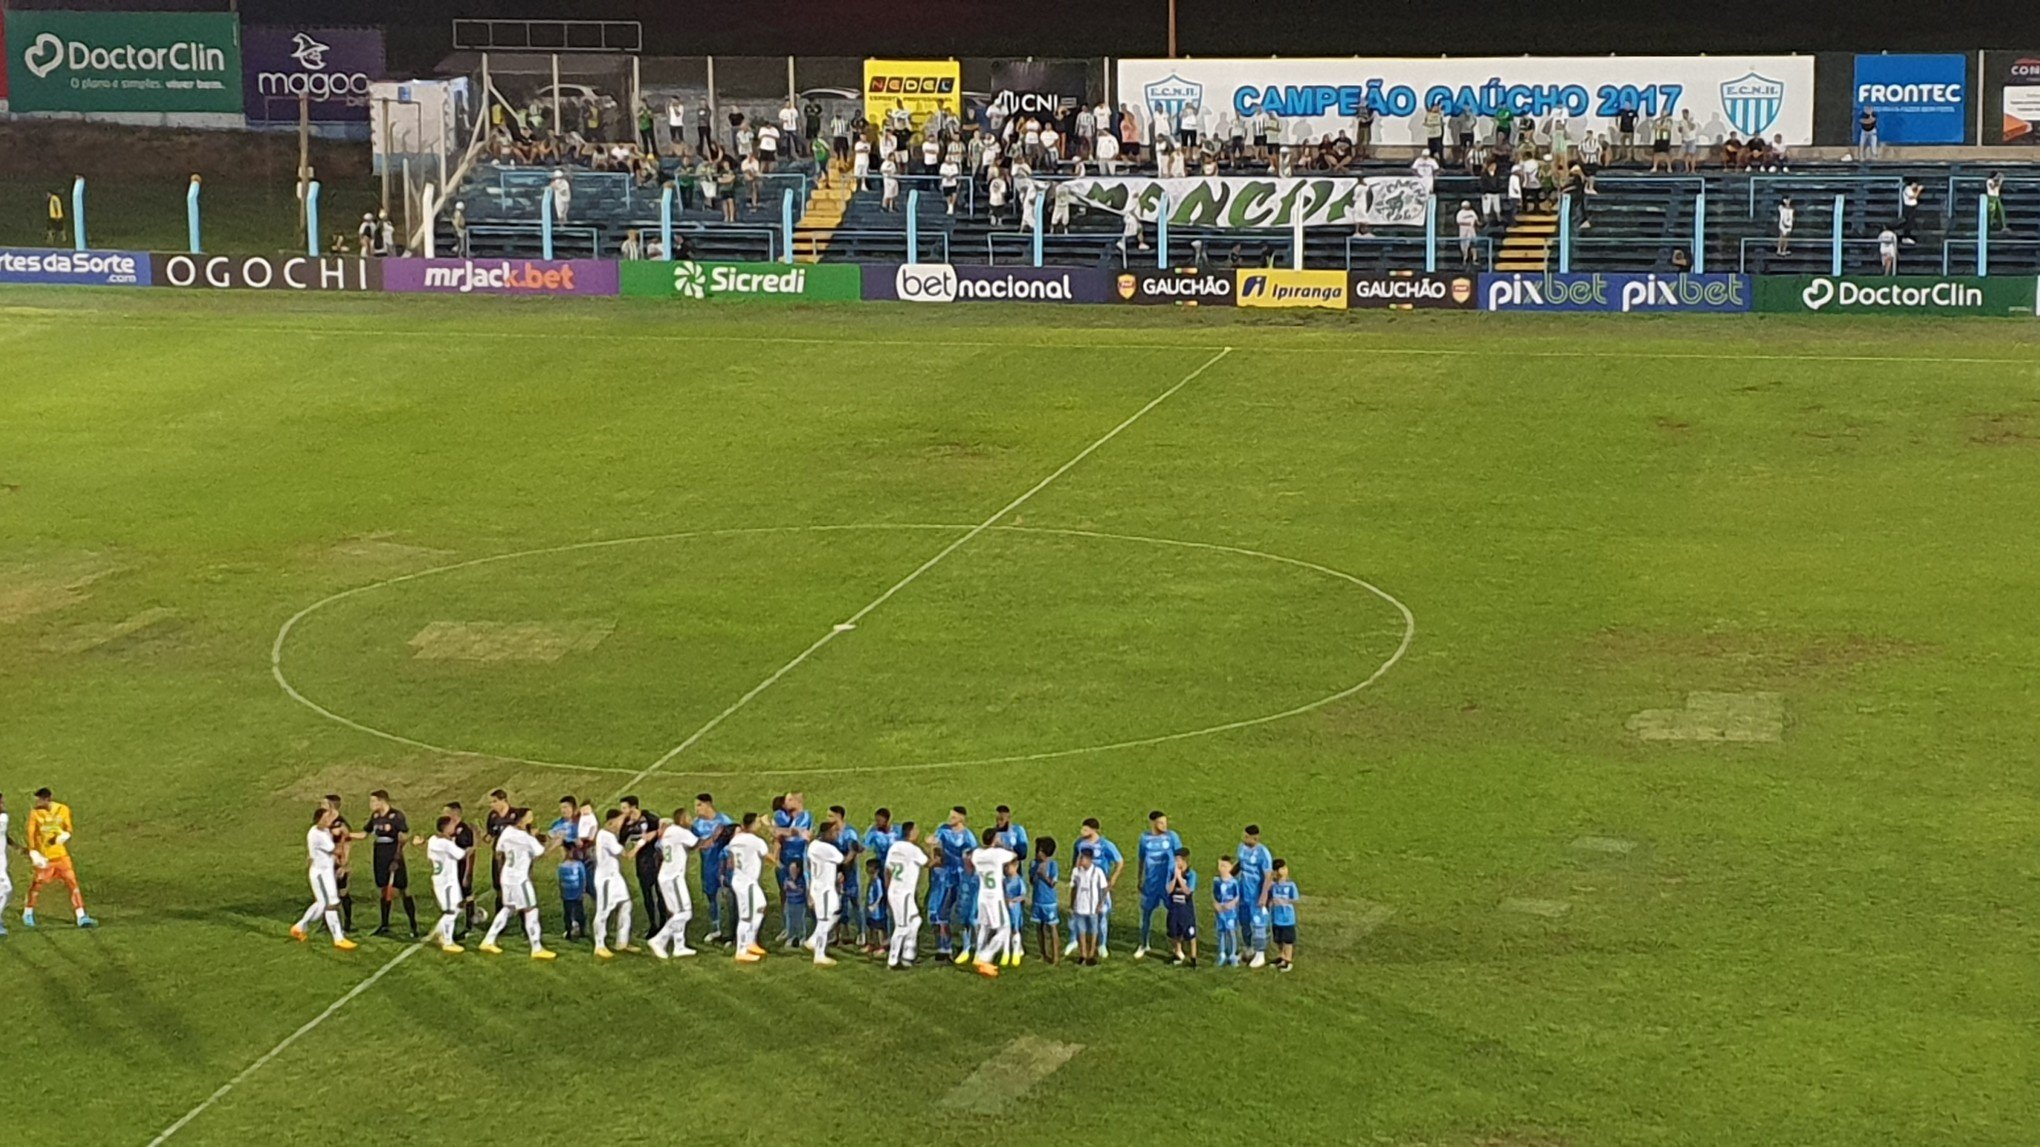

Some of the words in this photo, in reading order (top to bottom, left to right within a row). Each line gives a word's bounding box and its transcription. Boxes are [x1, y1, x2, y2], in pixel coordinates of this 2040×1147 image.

[68, 42, 225, 71] DoctorClin
[258, 72, 369, 102] magoo
[1233, 79, 1416, 118] CAMPEÃO
[1424, 78, 1590, 118] GAÚCHO
[1596, 84, 1684, 118] 2017
[1858, 84, 1961, 103] FRONTEC
[166, 255, 368, 290] OGOCHI
[424, 262, 576, 292] mrJack.bet
[709, 266, 806, 293] Sicredi
[1142, 275, 1230, 296] GAUCHÃO
[1272, 282, 1343, 301] Ipiranga
[1355, 278, 1446, 299] GAUCHÃO
[1488, 273, 1608, 312] pixbet
[1621, 273, 1744, 312] pixbet
[1839, 282, 1982, 307] DoctorClin
